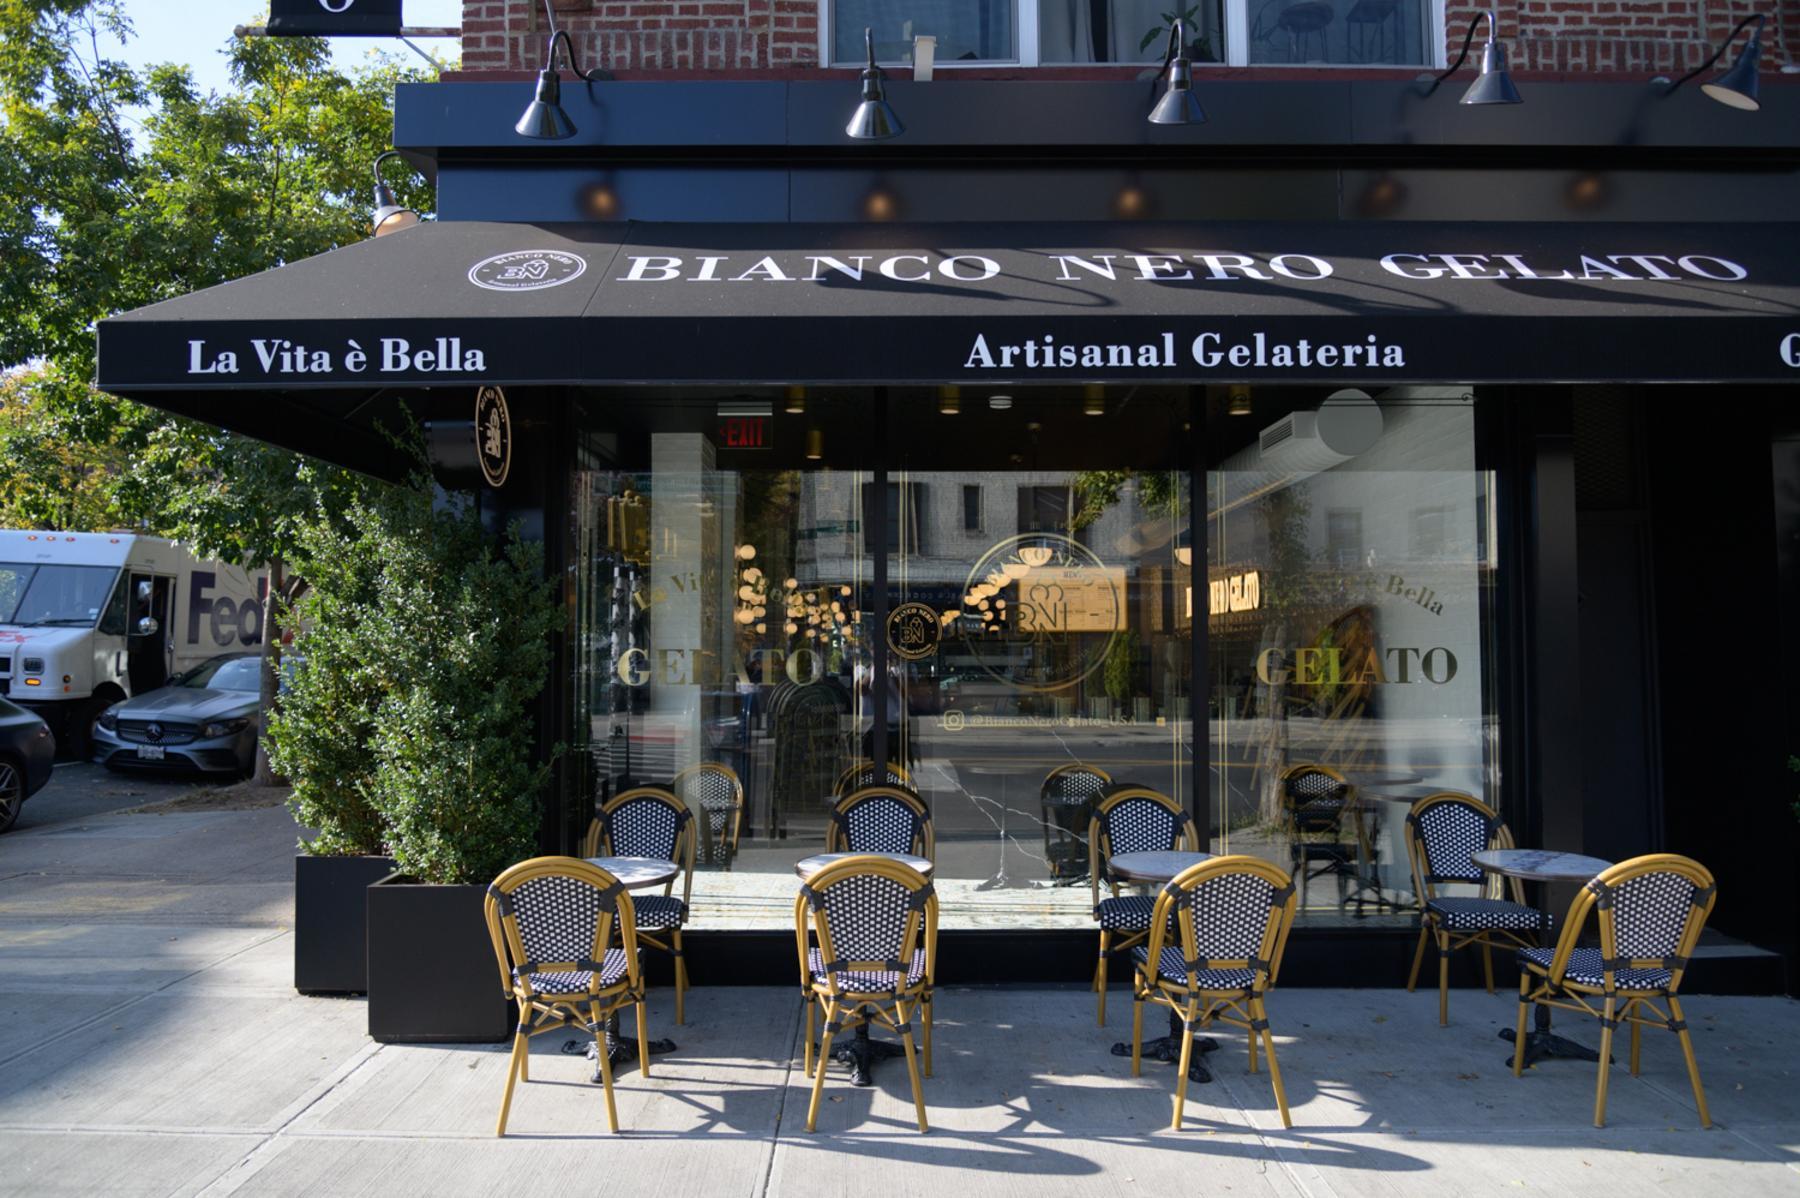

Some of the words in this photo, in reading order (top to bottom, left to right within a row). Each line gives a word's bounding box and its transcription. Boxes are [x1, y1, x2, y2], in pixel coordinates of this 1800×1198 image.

[616, 255, 1001, 282] BIANCO
[1055, 255, 1333, 281] NERO
[1380, 254, 1748, 281] GELATO
[188, 341, 239, 373] La
[251, 340, 332, 373] Vita
[345, 339, 366, 372] è
[380, 338, 486, 372] Bella
[964, 333, 1176, 369] Artisanal
[1192, 332, 1405, 369] Gelateria
[727, 418, 763, 447] EXIT
[1385, 574, 1445, 617] Bella
[1256, 647, 1458, 685] GELATO
